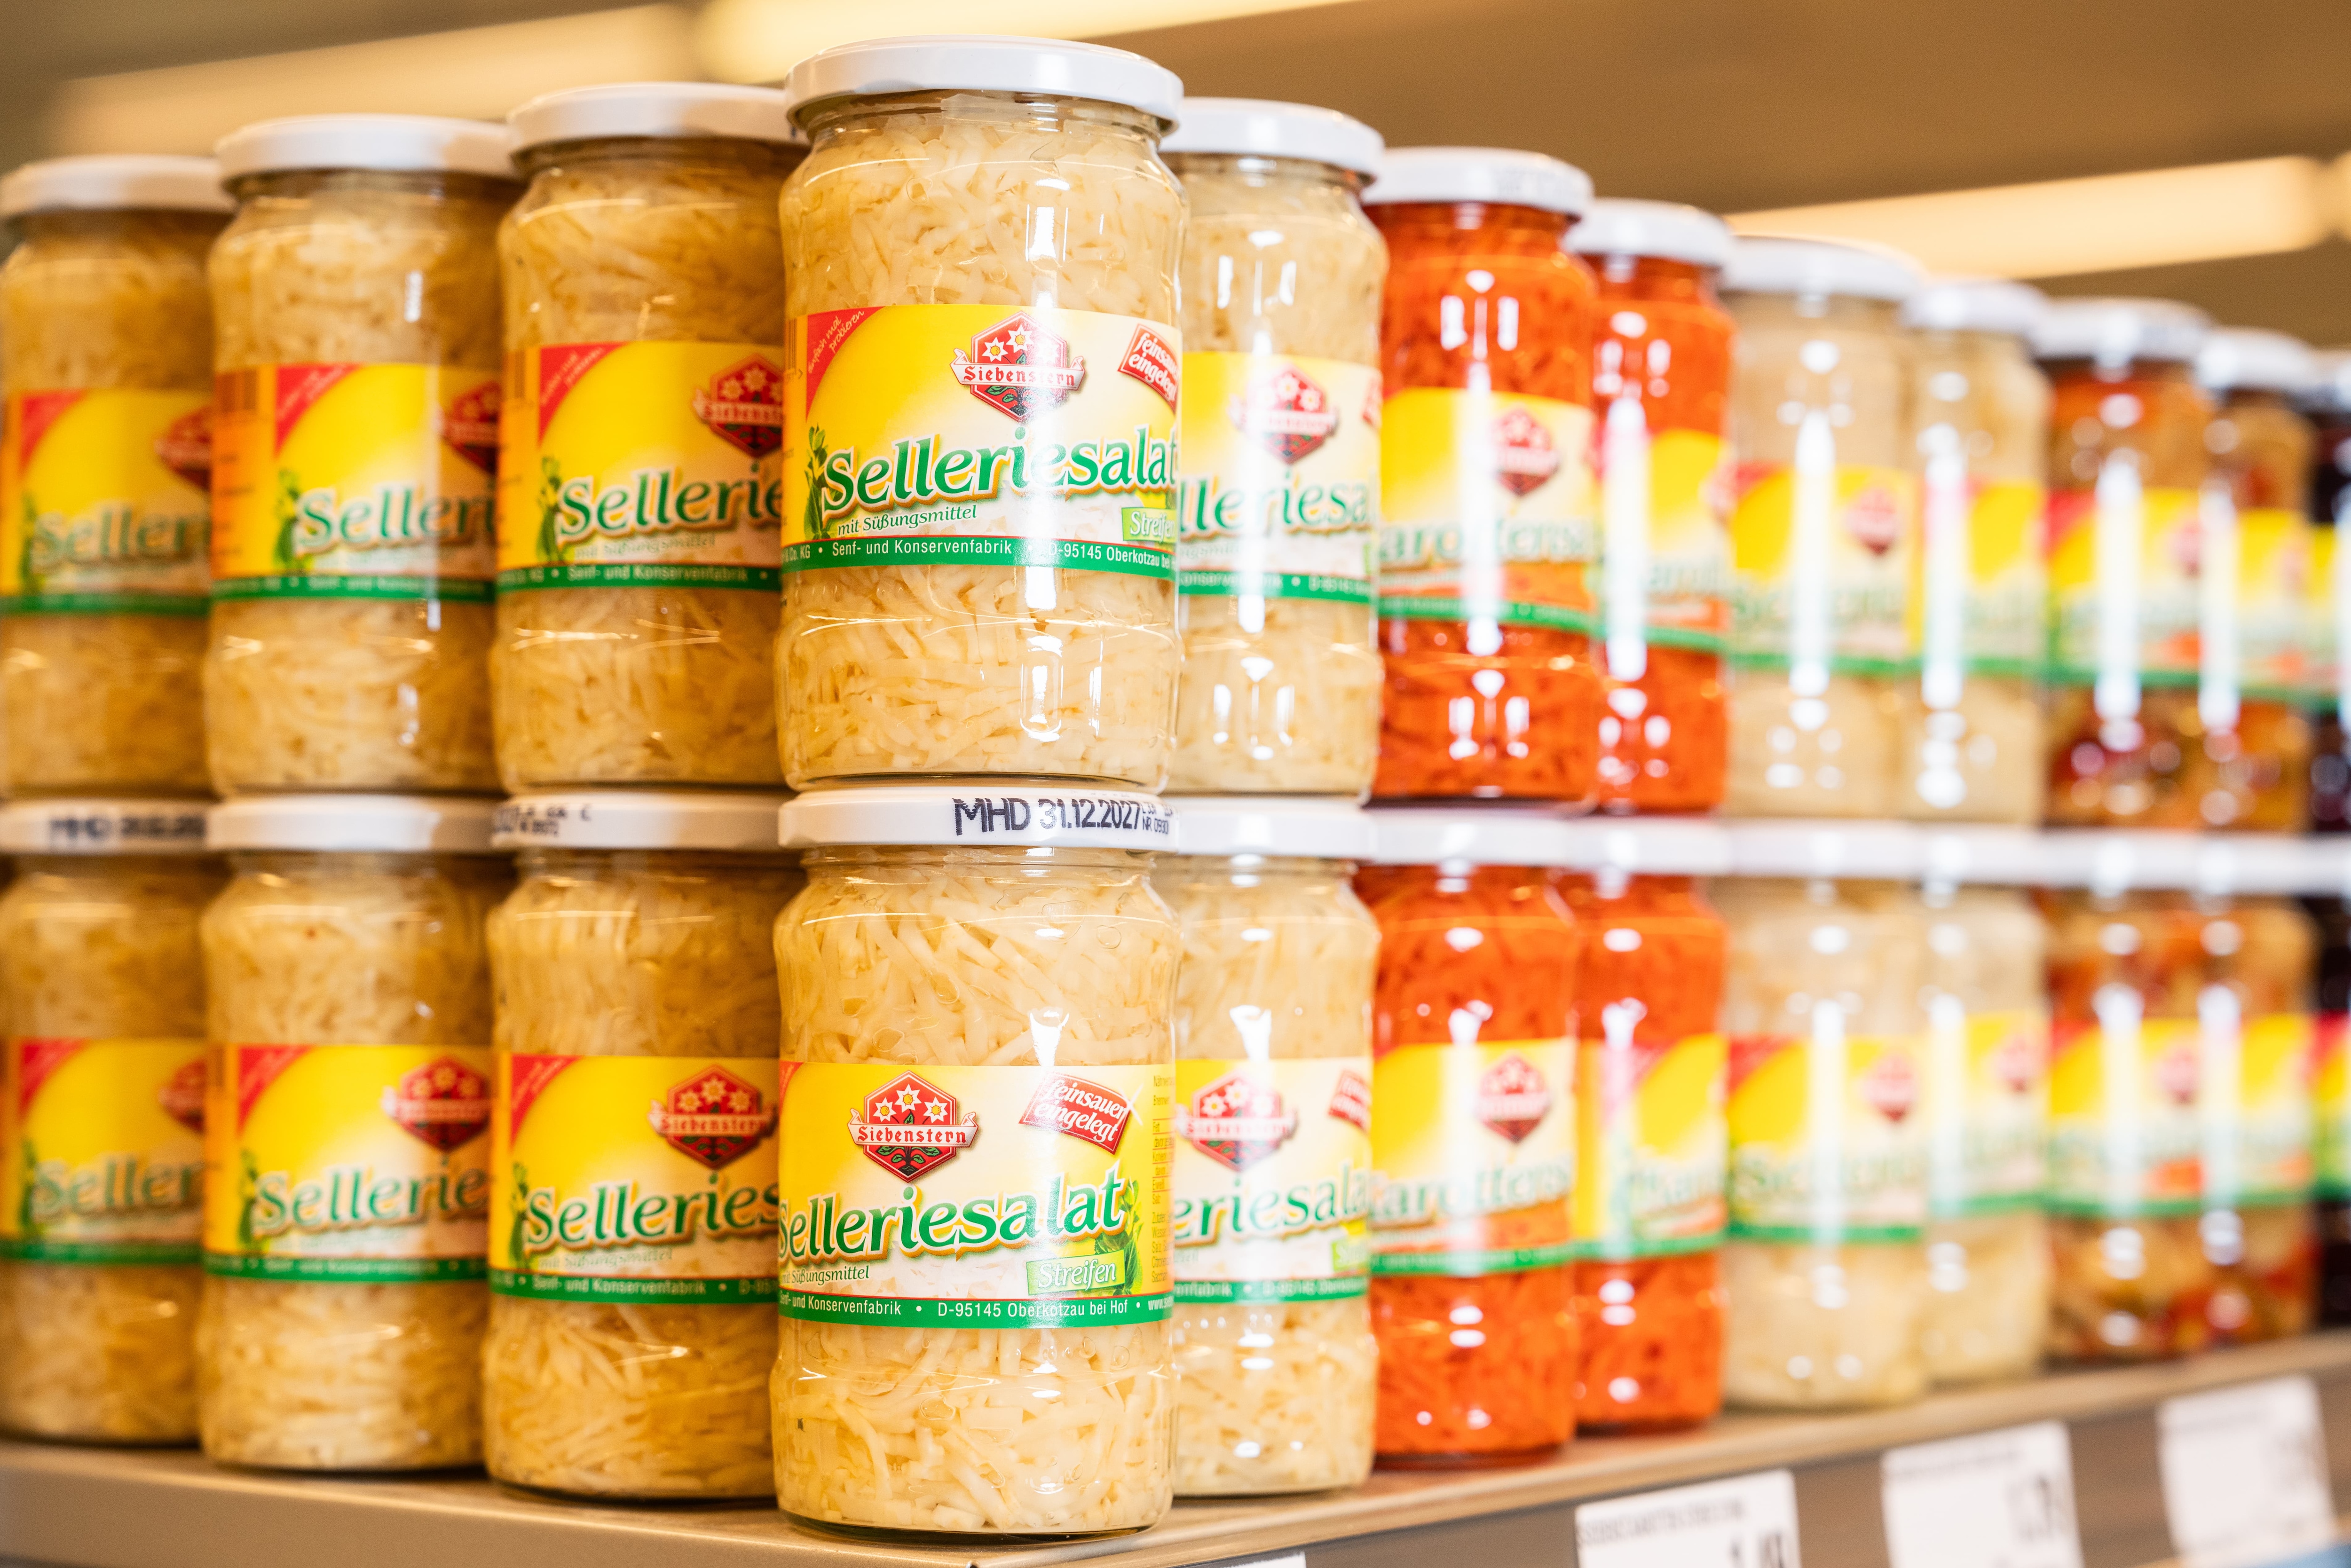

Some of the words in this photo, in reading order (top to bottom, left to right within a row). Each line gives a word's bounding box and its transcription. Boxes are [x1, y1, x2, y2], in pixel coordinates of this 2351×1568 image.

[825, 315, 842, 339] mal
[828, 310, 865, 354] probieren
[963, 365, 1075, 387] Siebenstern
[824, 425, 1177, 512] Selleriesalat
[837, 519, 860, 536] mit
[863, 504, 977, 531] Süßungsmittel
[1130, 510, 1176, 543] Streifen
[800, 544, 811, 559] KG
[832, 542, 861, 556] Senf-
[866, 540, 889, 554] und
[895, 539, 1012, 554] Konservenfabrik
[1049, 542, 1102, 560] D-95145
[1106, 546, 1160, 567] Oberkotzau
[952, 798, 1031, 835] MHD
[1038, 798, 1141, 830] 31.12.2027
[1044, 1079, 1128, 1120] feinsauer
[858, 1126, 966, 1143] Siebenstern
[1035, 1103, 1120, 1143] eingelegt
[779, 1171, 1125, 1260] Selleriesalat
[792, 1265, 869, 1286] Süßungsmittel
[1038, 1262, 1117, 1292] Streifen
[793, 1295, 805, 1308] und
[808, 1295, 901, 1315] Konservenfabrik
[938, 1302, 1001, 1317] D-95145
[1008, 1301, 1085, 1316] Oberkotzau
[1089, 1300, 1106, 1315] bei
[1110, 1300, 1128, 1314] Hof
